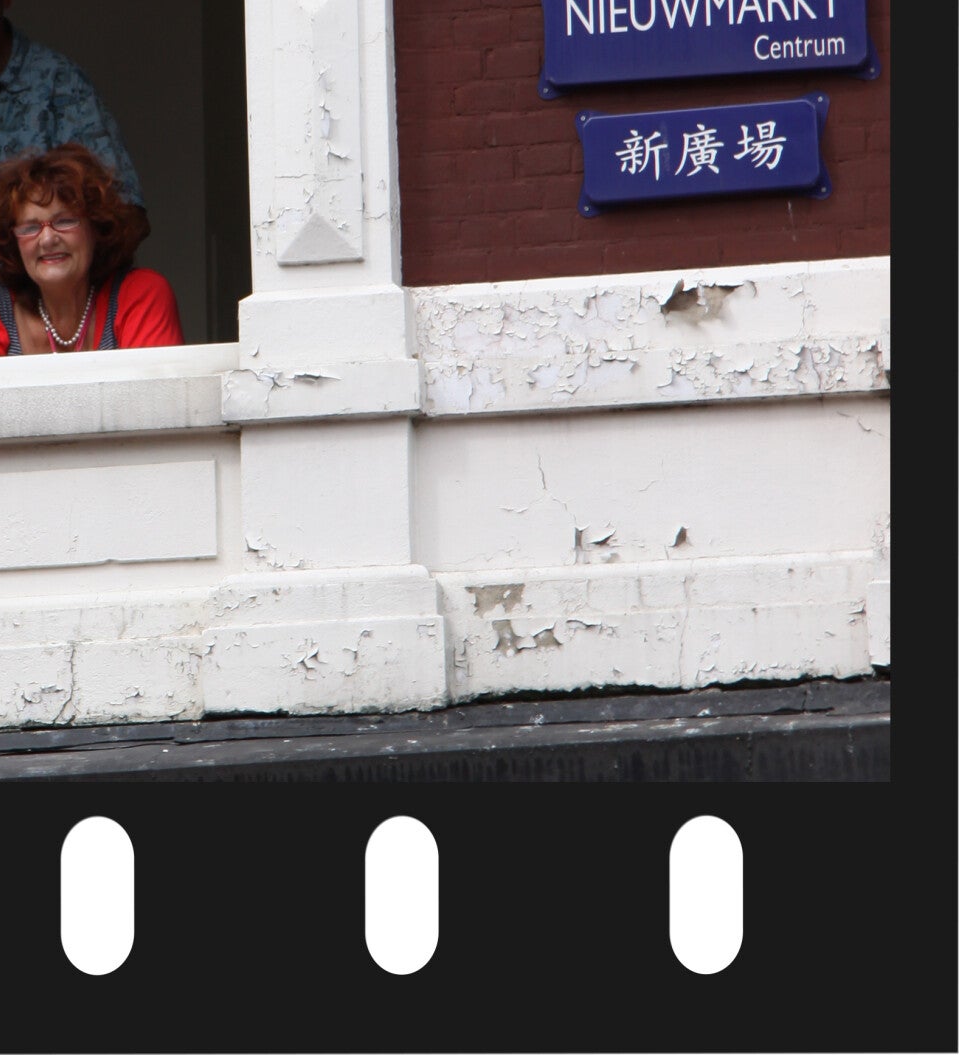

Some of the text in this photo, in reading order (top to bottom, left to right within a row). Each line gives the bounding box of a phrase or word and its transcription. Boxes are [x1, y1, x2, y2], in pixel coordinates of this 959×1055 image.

[754, 34, 846, 61] Centrum
[615, 121, 787, 181] 新廣場
